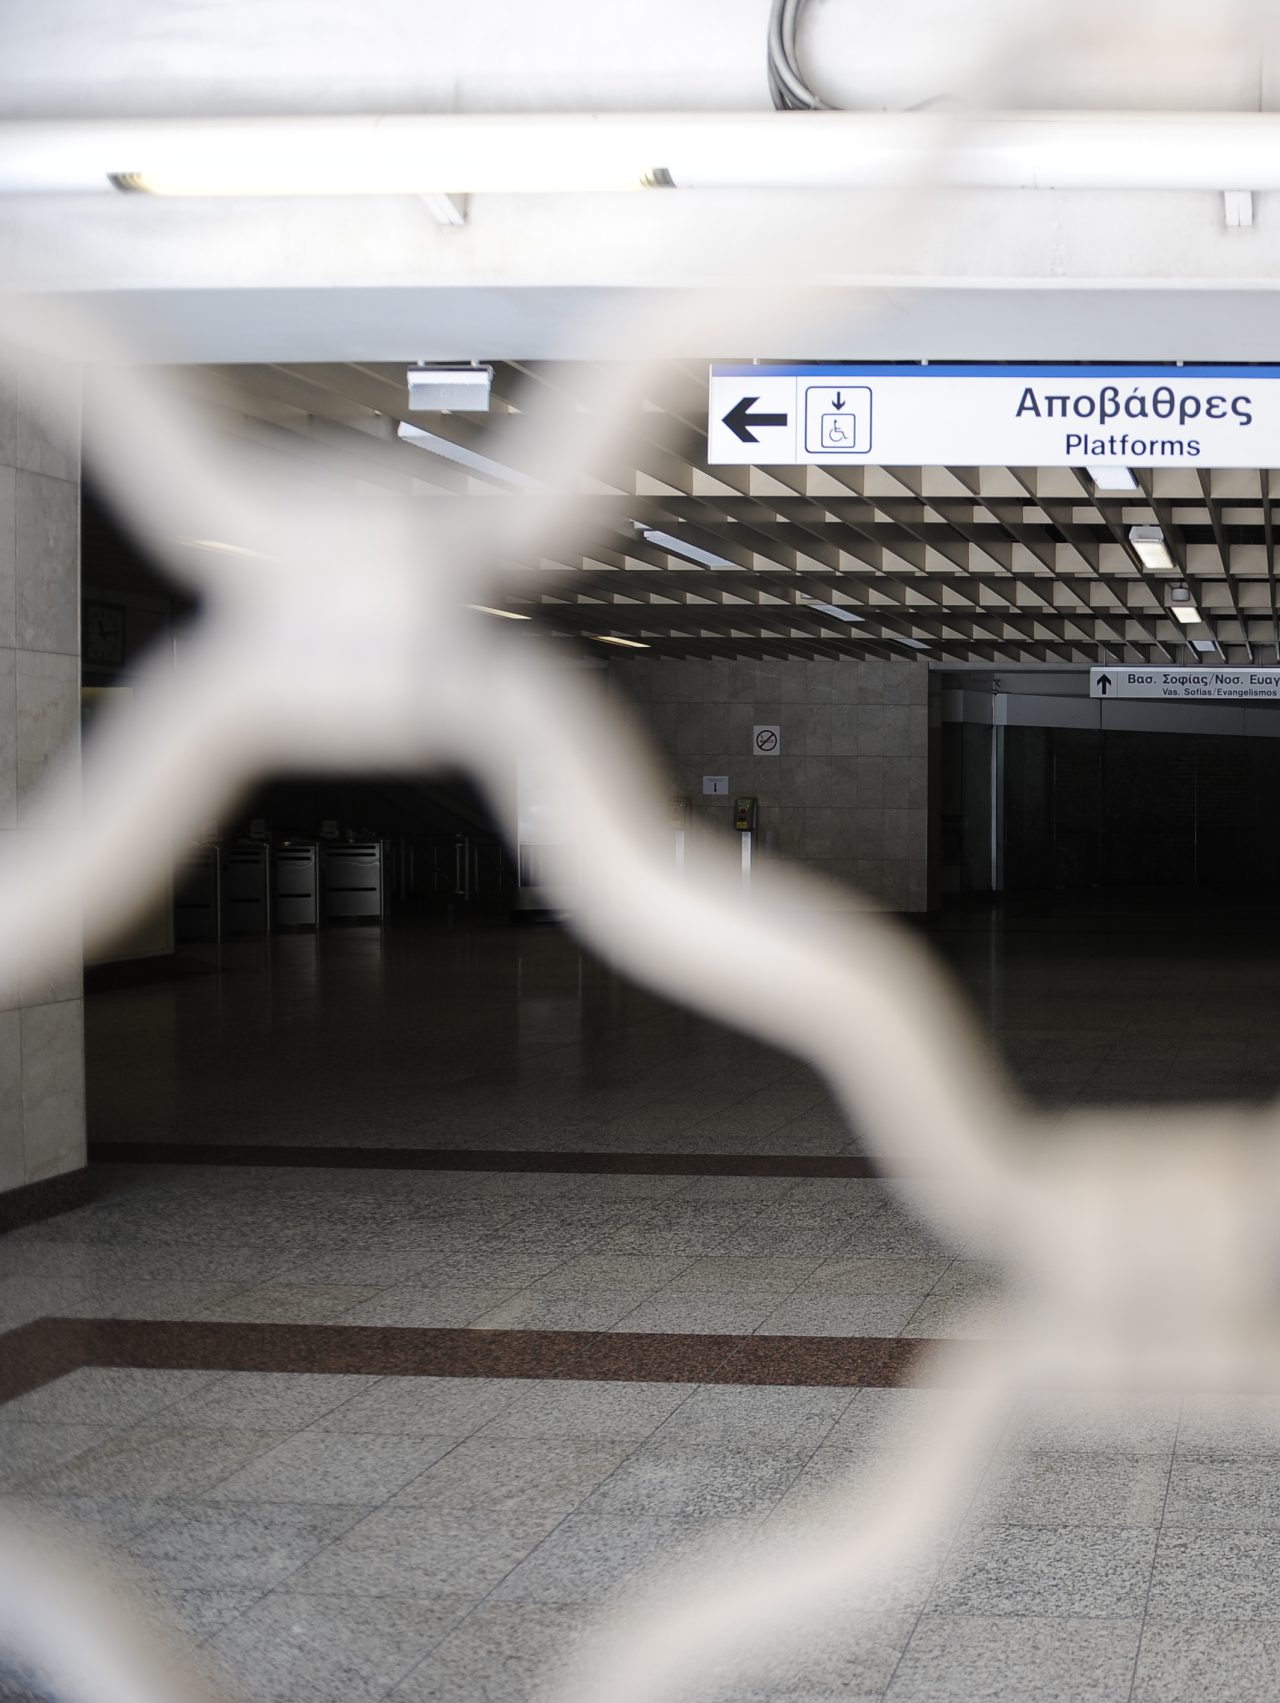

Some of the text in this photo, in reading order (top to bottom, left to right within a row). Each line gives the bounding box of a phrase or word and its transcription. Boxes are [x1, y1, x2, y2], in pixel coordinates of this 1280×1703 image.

[1015, 386, 1253, 426] Αποβάθρες
[1065, 433, 1201, 457] Platforms
[1127, 673, 1157, 685] Βασ.
[1162, 673, 1244, 687] Σοφίας/Νοσ.
[1162, 688, 1180, 696] Vas.
[1184, 687, 1278, 698] Sofias/Evangelismos
